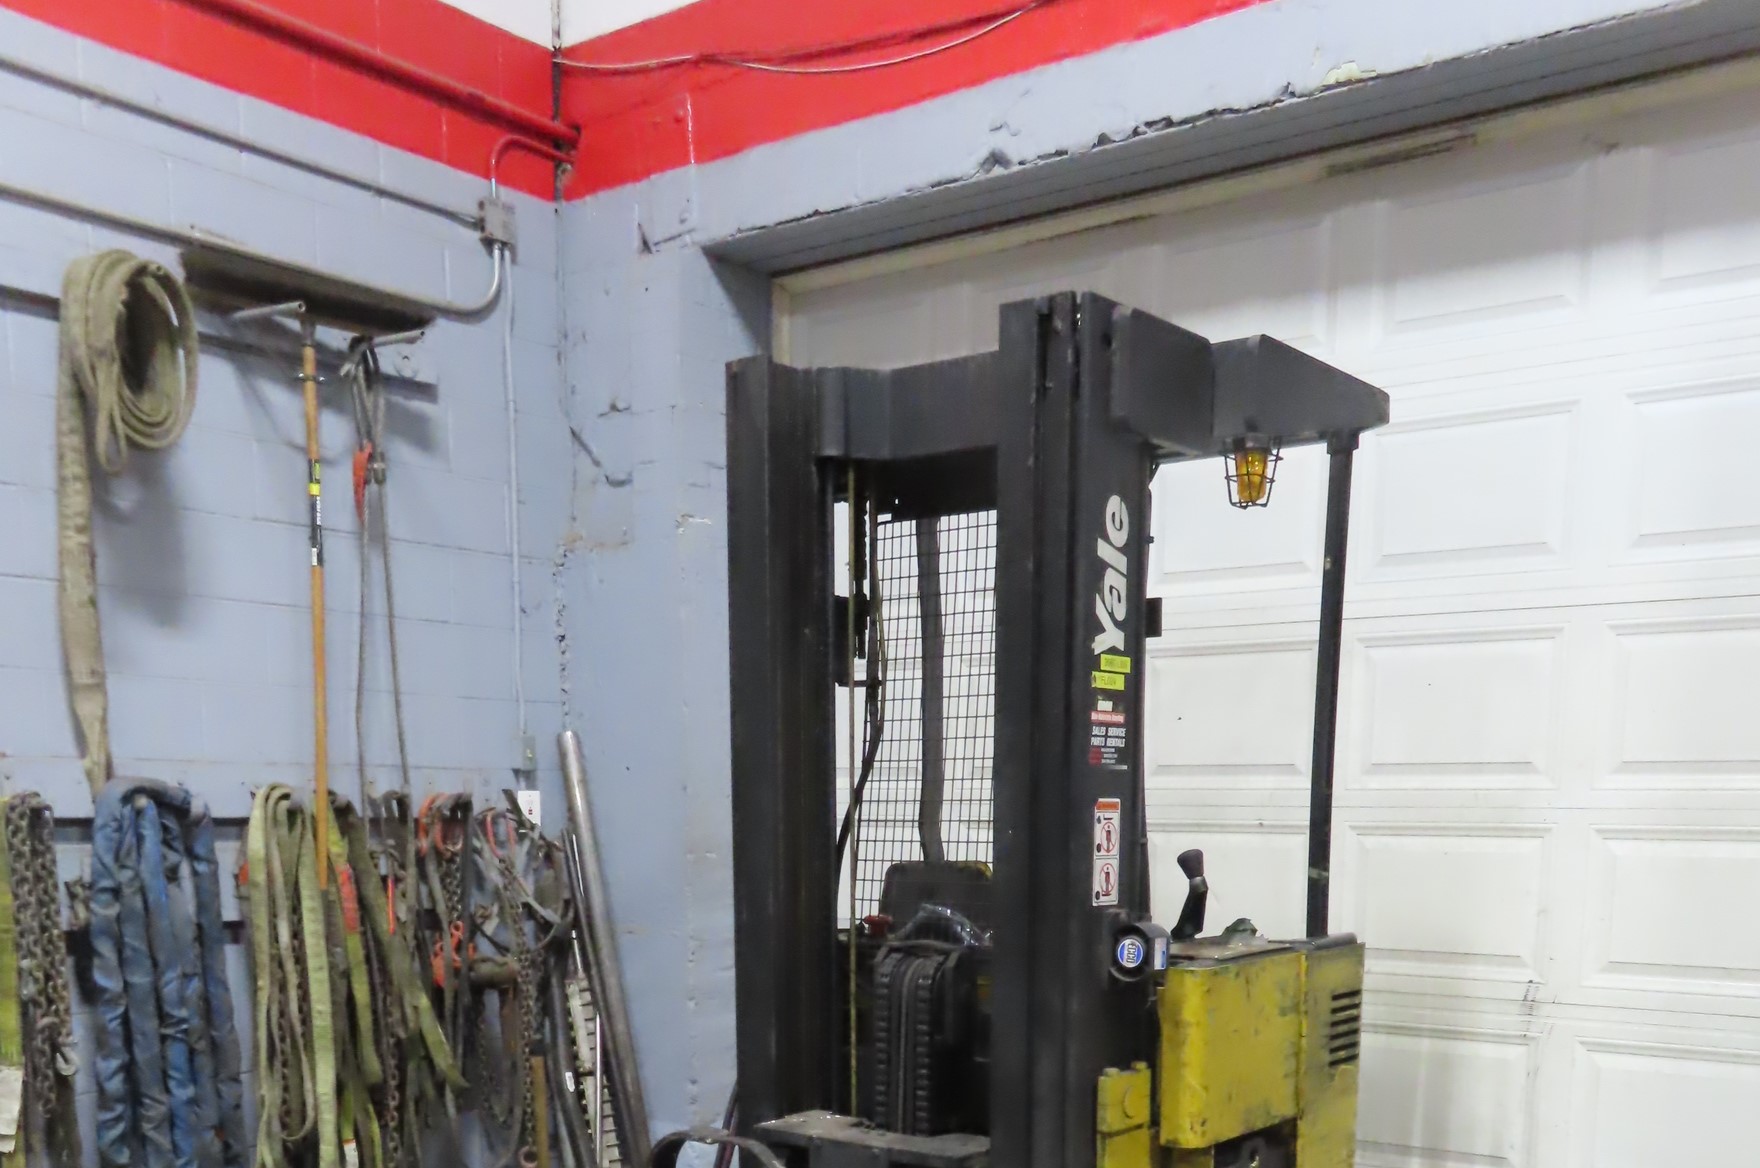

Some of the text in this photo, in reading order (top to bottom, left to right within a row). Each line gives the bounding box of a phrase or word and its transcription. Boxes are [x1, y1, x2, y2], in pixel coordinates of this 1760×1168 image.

[1092, 494, 1129, 656] Yale
[1091, 726, 1127, 737] SALES SERVICE
[1126, 942, 1137, 963] ECCO
